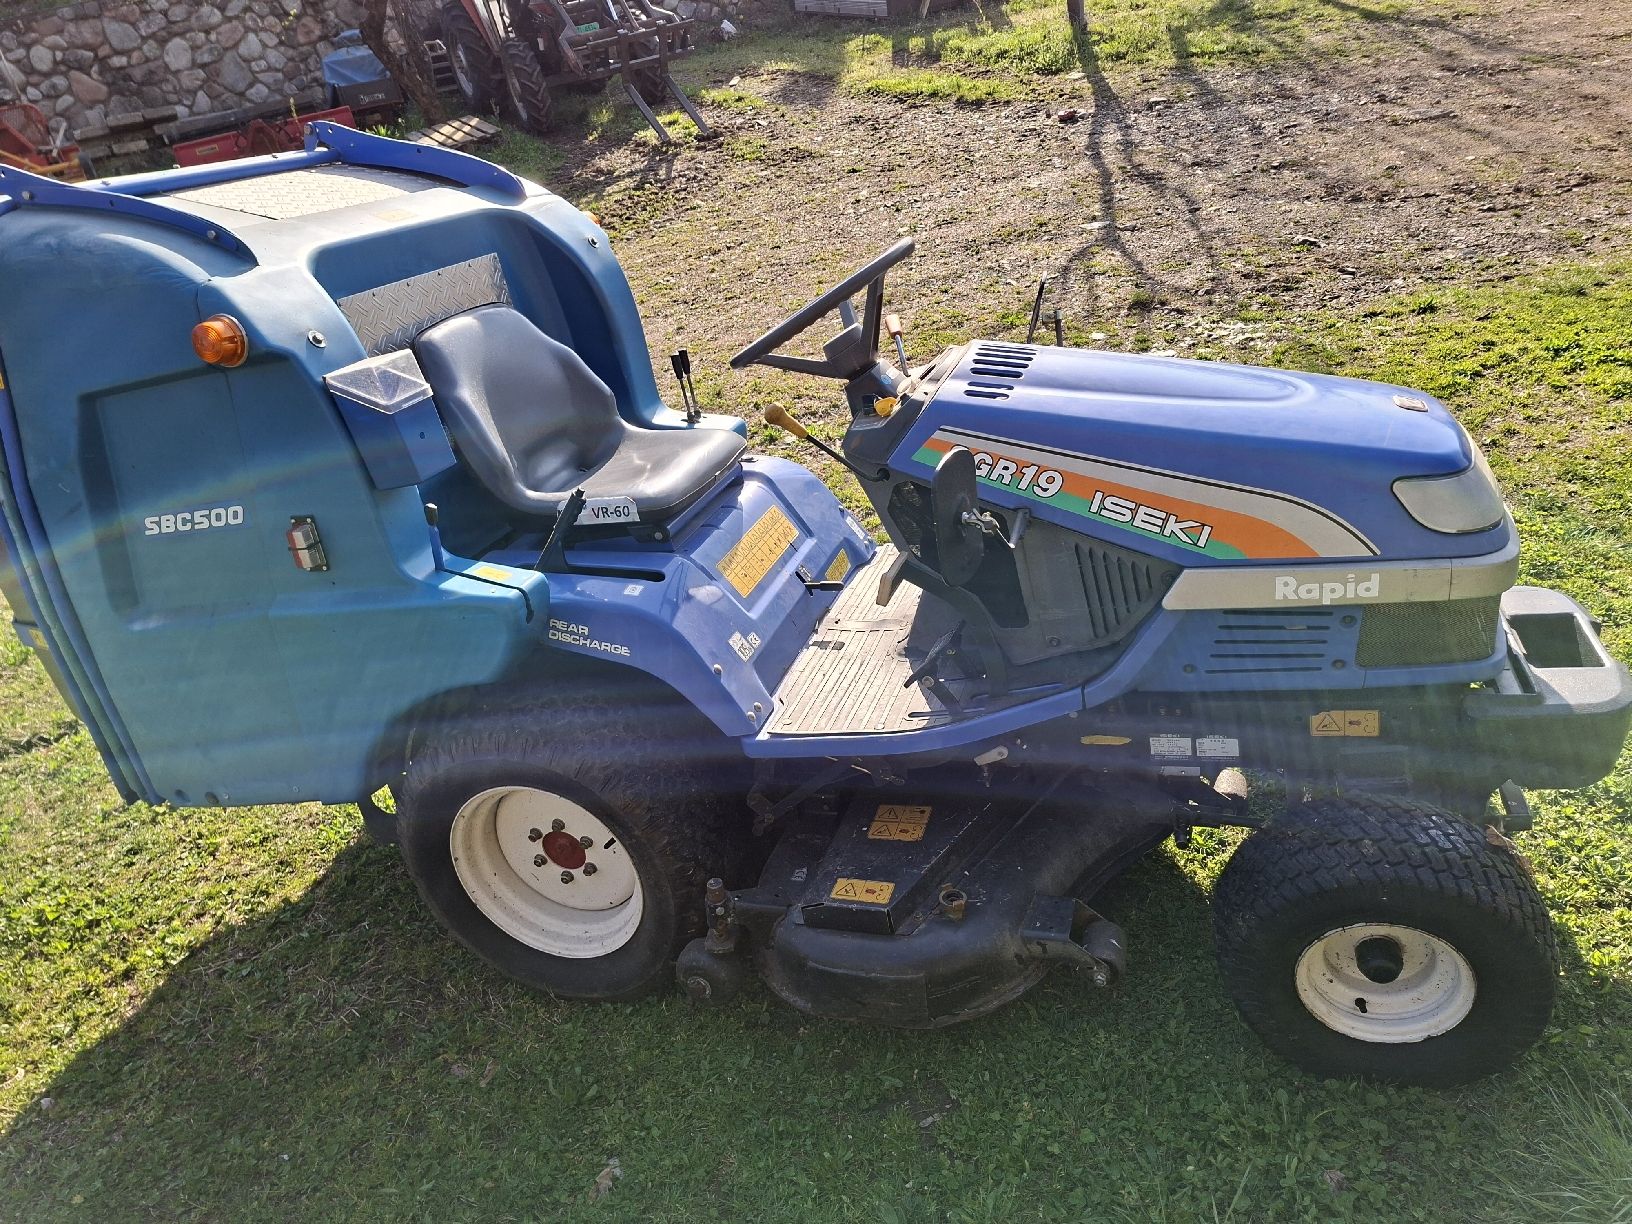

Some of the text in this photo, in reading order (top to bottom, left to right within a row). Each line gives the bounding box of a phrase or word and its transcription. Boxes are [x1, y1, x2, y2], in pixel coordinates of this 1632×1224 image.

[950, 444, 1063, 499] GR19
[144, 505, 244, 536] SBC500
[591, 505, 631, 519] VR-60
[1088, 490, 1213, 548] ISEKI
[1275, 572, 1380, 605] Rapid
[549, 618, 589, 636] REAR
[548, 629, 632, 657] DISCHARGE
